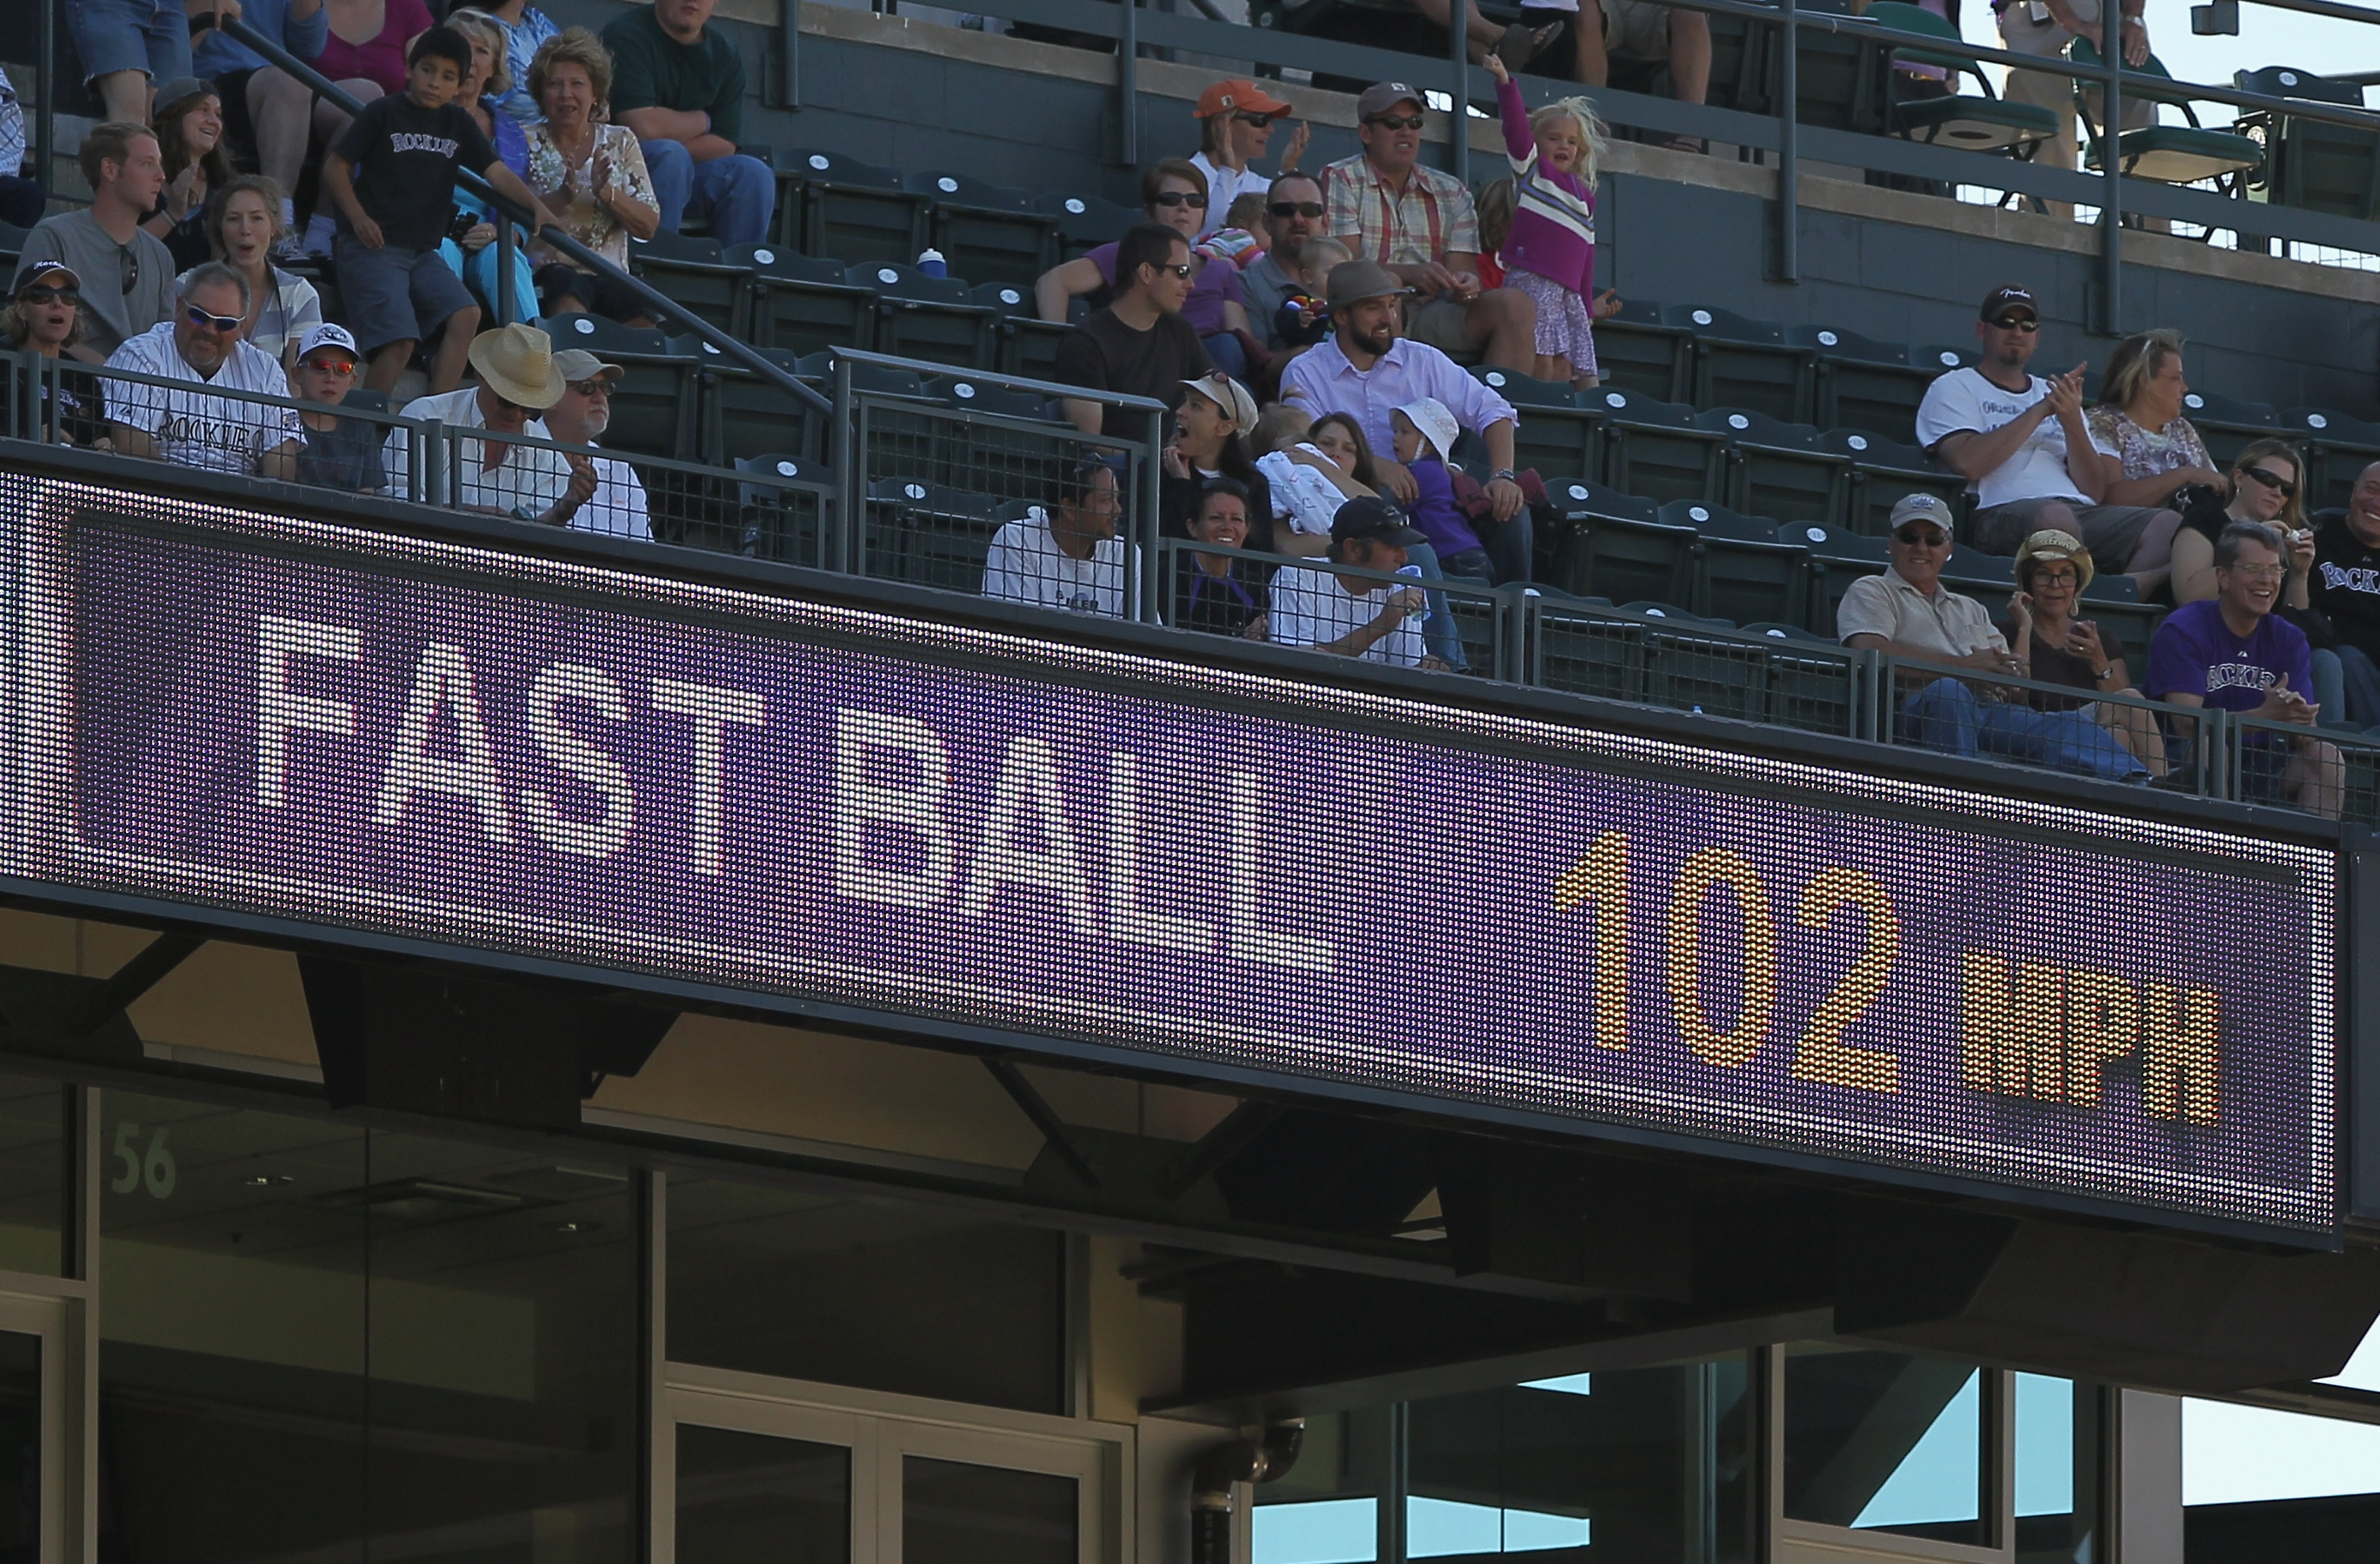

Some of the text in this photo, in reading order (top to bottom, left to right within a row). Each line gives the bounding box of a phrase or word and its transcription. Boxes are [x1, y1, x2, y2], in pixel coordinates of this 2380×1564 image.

[390, 133, 460, 158] ROCKIES
[154, 411, 265, 458] ROCKIES
[2319, 562, 2380, 595] ROCK
[258, 614, 2222, 1128] FAST BALL 102 MPH
[112, 1123, 176, 1199] 56
